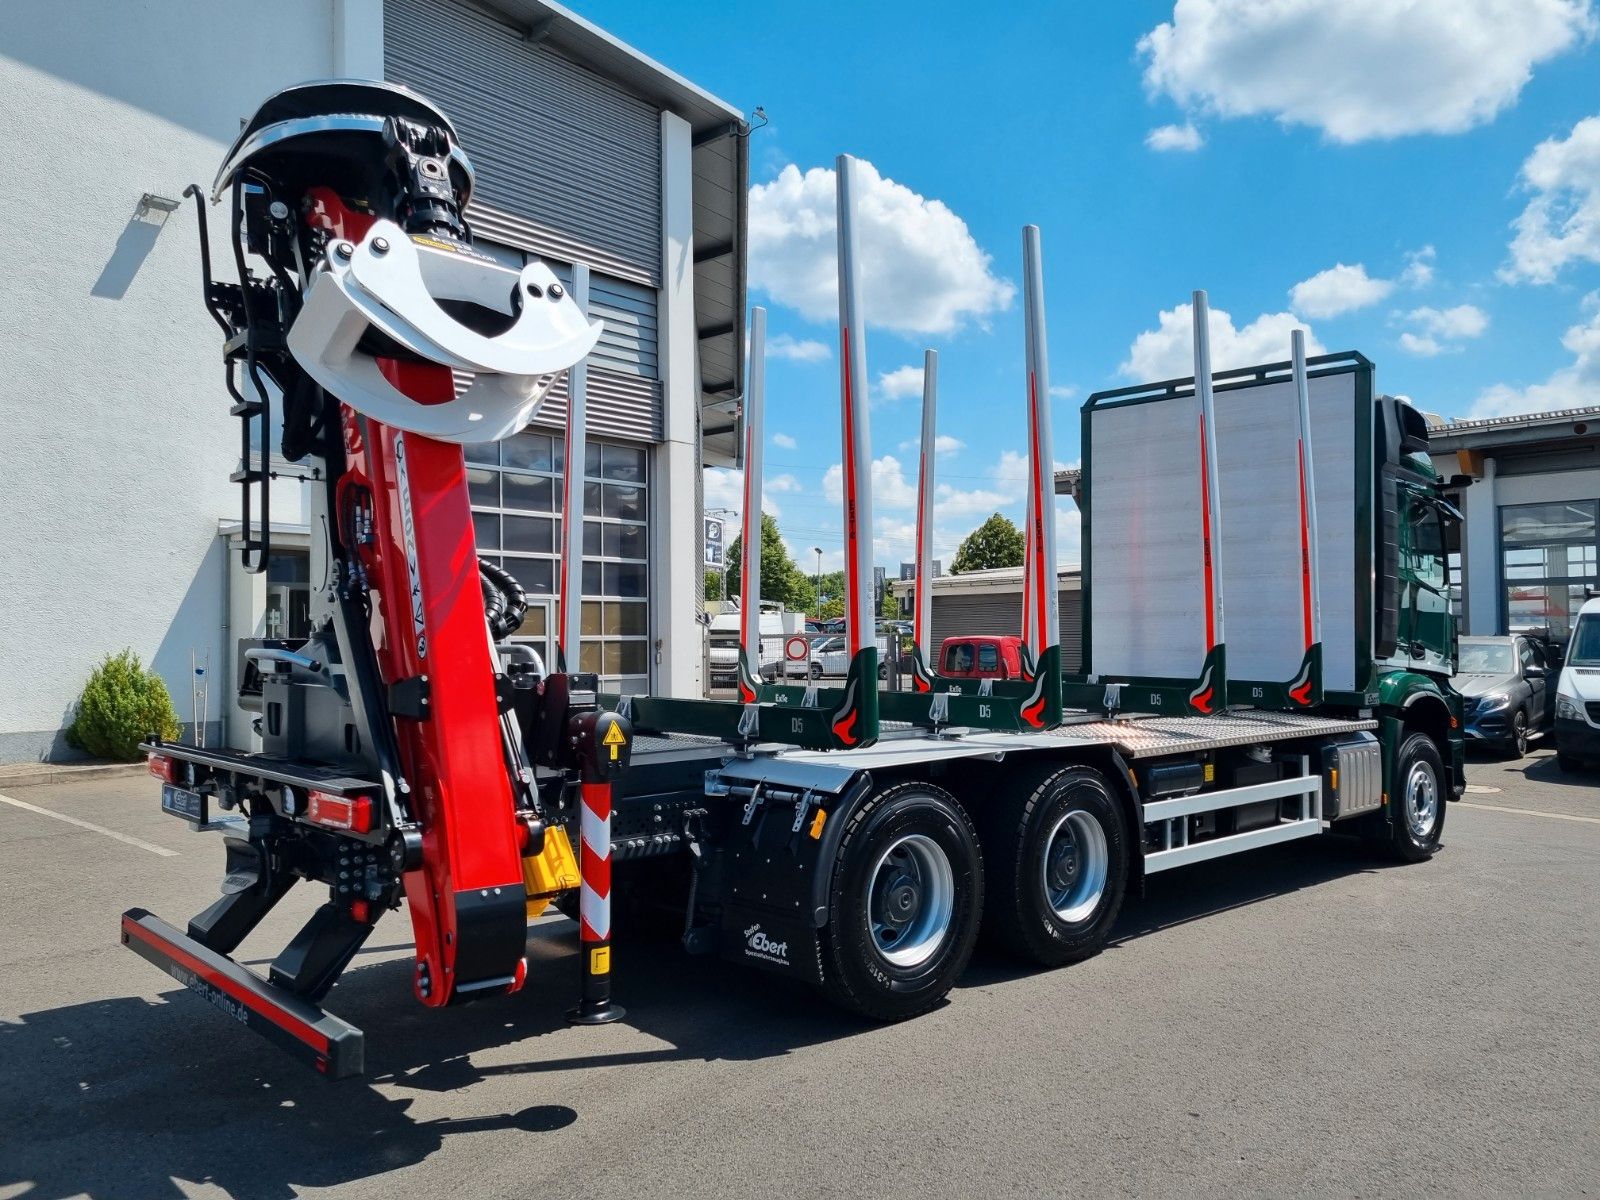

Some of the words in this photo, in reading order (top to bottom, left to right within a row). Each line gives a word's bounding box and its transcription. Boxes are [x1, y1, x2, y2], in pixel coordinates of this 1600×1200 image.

[1150, 693, 1161, 705] D5
[1253, 687, 1263, 698] D5
[979, 704, 991, 718] D5
[791, 717, 803, 733] D5
[751, 932, 788, 957] Ebert
